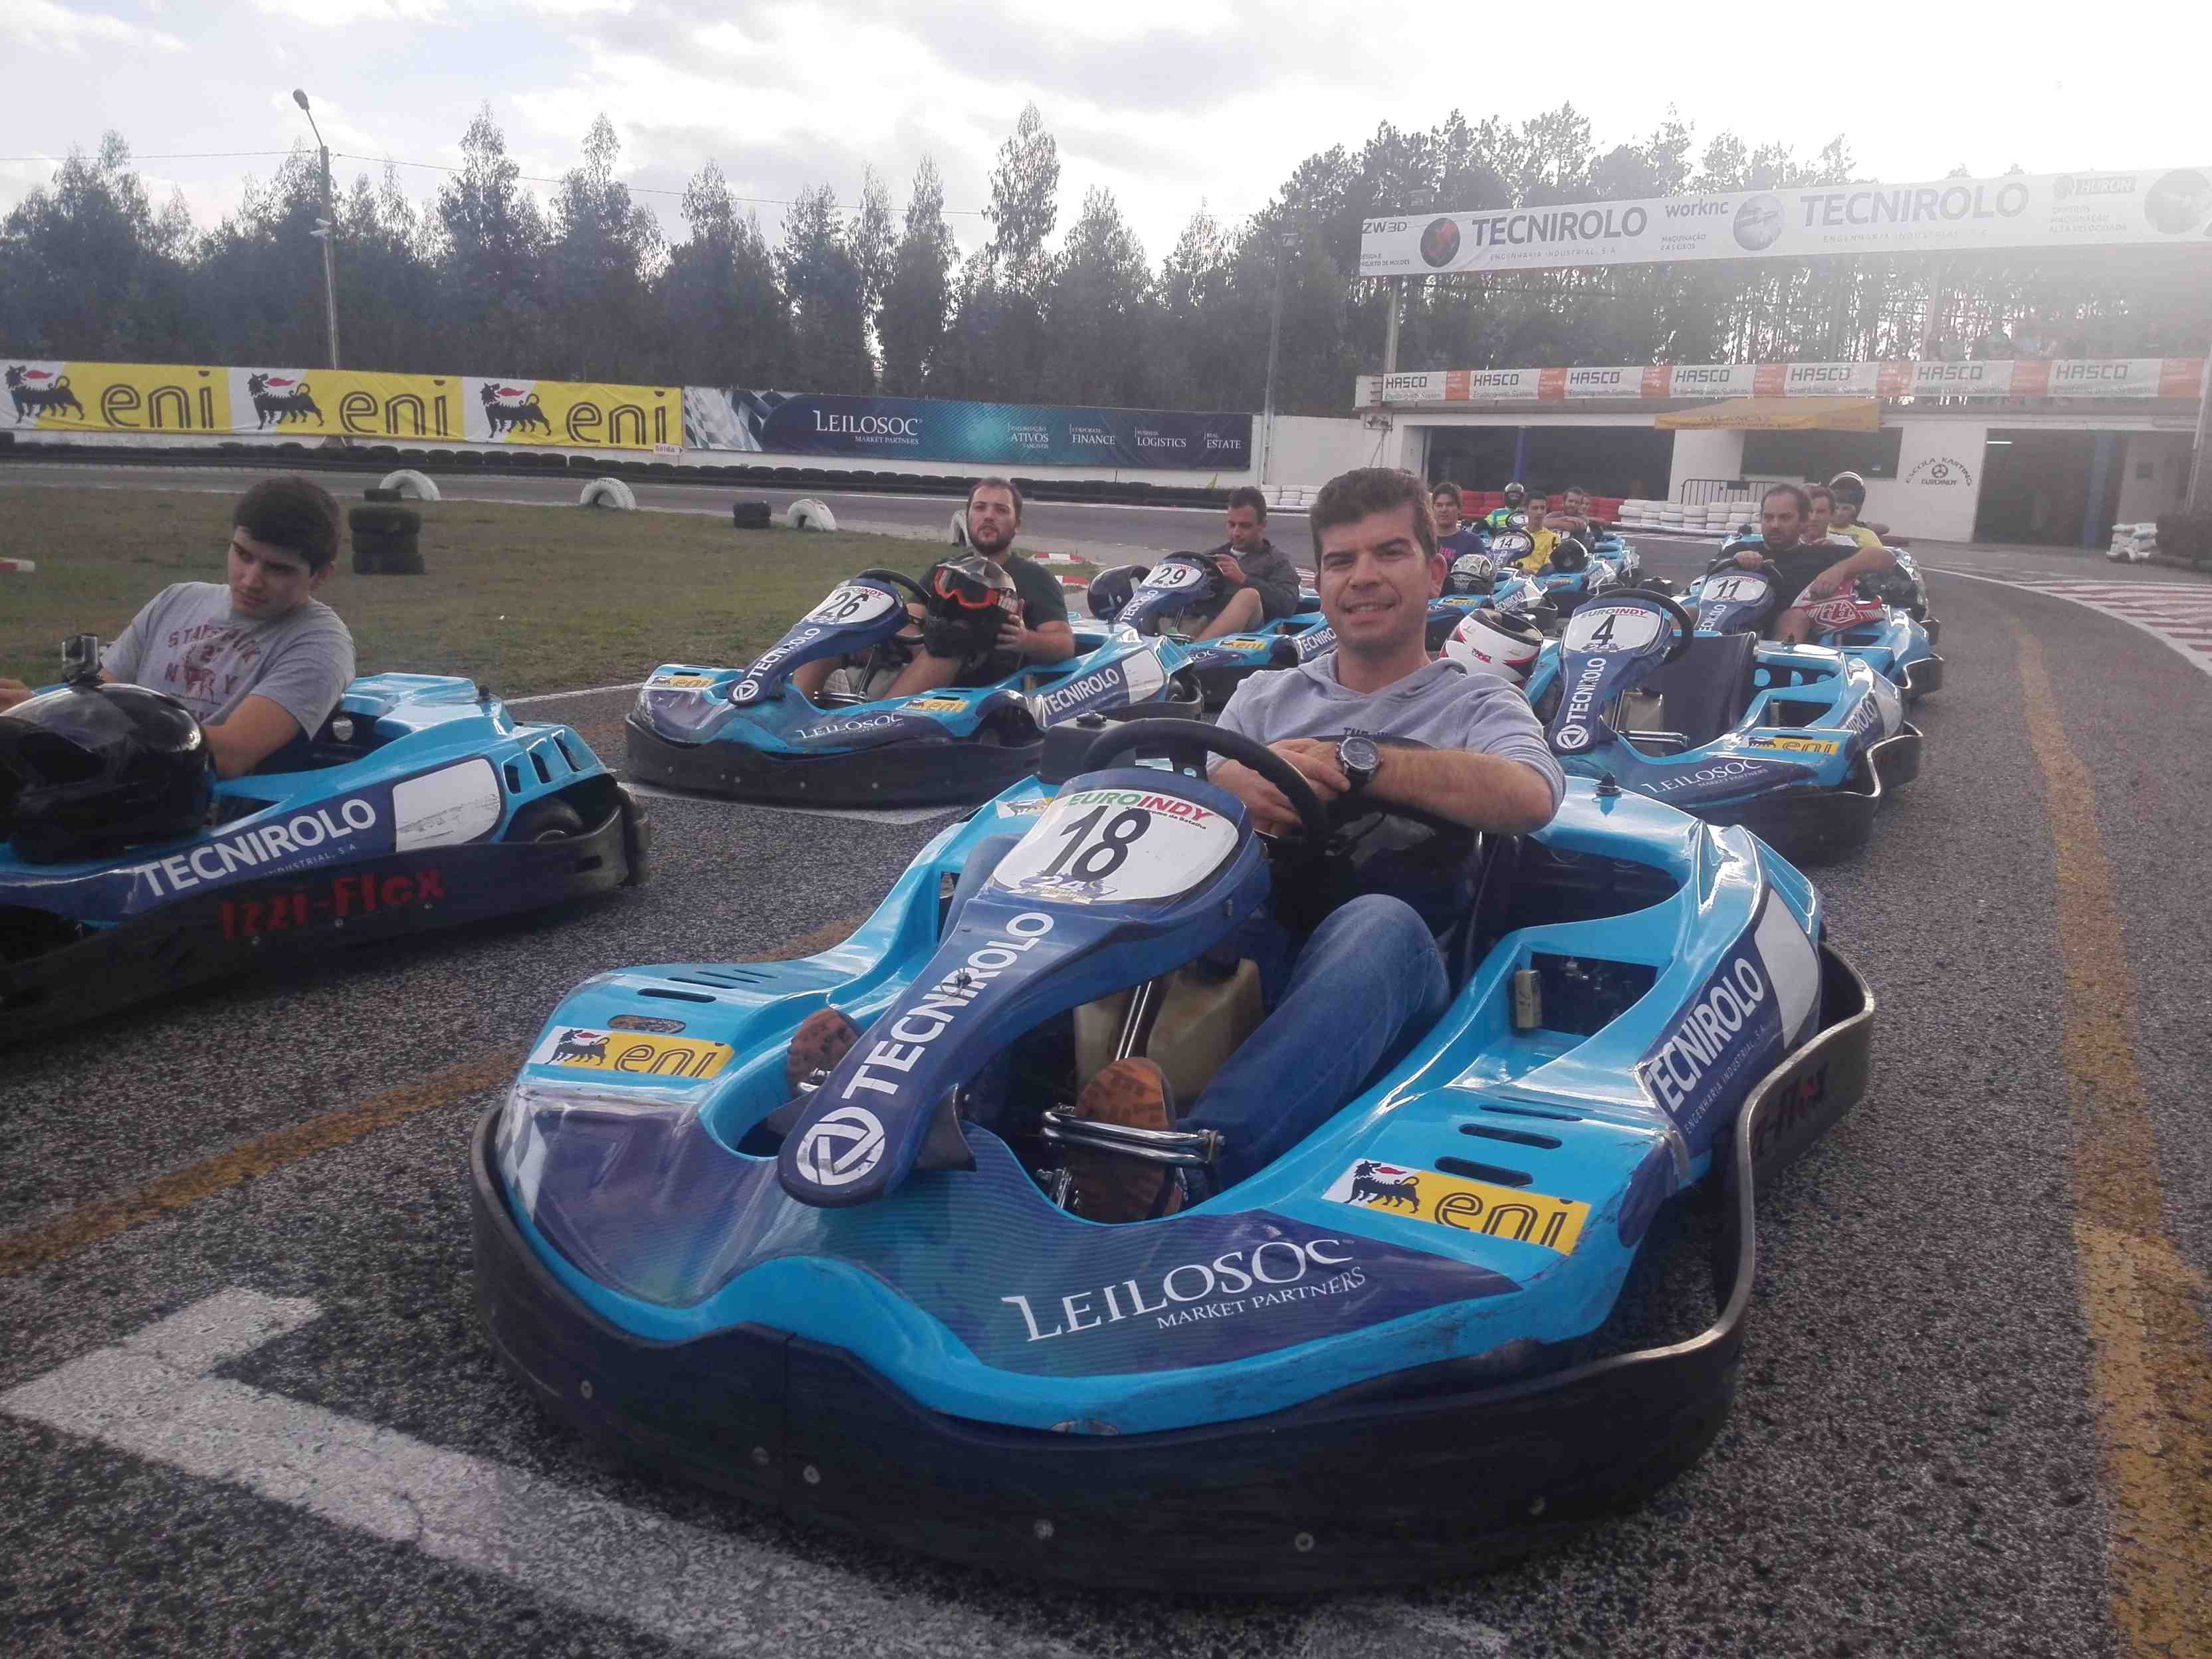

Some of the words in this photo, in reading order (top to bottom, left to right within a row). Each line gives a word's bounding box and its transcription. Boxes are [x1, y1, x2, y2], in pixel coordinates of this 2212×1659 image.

[1799, 182, 2029, 227] TECNIROLO
[1472, 207, 1648, 246] TECNIROLO
[1385, 375, 1427, 389] HASCO
[1474, 374, 1519, 387] HASCO
[1569, 372, 1620, 384] HASCO
[1675, 370, 1731, 383] HASCO
[1791, 368, 1850, 381] HASCO
[1918, 366, 1983, 380] HASCO
[2056, 364, 2128, 380] HASCO
[100, 370, 217, 429] eni
[339, 380, 448, 437] eni
[566, 391, 666, 444] eni
[812, 409, 919, 436] LEILOSOC
[885, 436, 919, 445] PARTNERS
[1010, 433, 1049, 443] ATIVOS
[1072, 435, 1116, 445] FINANCE
[1137, 438, 1187, 448] LOGISTICS
[1207, 440, 1242, 450] ESTATE
[1499, 538, 1513, 548] 14
[1152, 567, 1186, 585] 29
[1717, 580, 1741, 598] 11
[816, 592, 869, 618] 26
[1591, 614, 1615, 645] 4
[1044, 668, 1119, 716] TECNIROLO
[796, 712, 904, 739] LEILOSOC
[1782, 740, 1834, 753] eni
[1641, 760, 1761, 793] LEILOSOC
[1068, 792, 1214, 820] EUROINDY
[132, 799, 376, 897] TECNIROLO
[1040, 806, 1152, 881] 18
[842, 912, 1055, 1099] TECNIROLO
[1644, 957, 1765, 1113] TECNIROLO
[613, 1042, 727, 1077] eni
[1683, 1083, 1723, 1135] ENGENHARIA
[1434, 1191, 1574, 1247] eni
[1002, 1239, 1355, 1342] LEILOSOC
[1157, 1299, 1248, 1329] MARKET
[1250, 1266, 1367, 1308] PARTNERS
